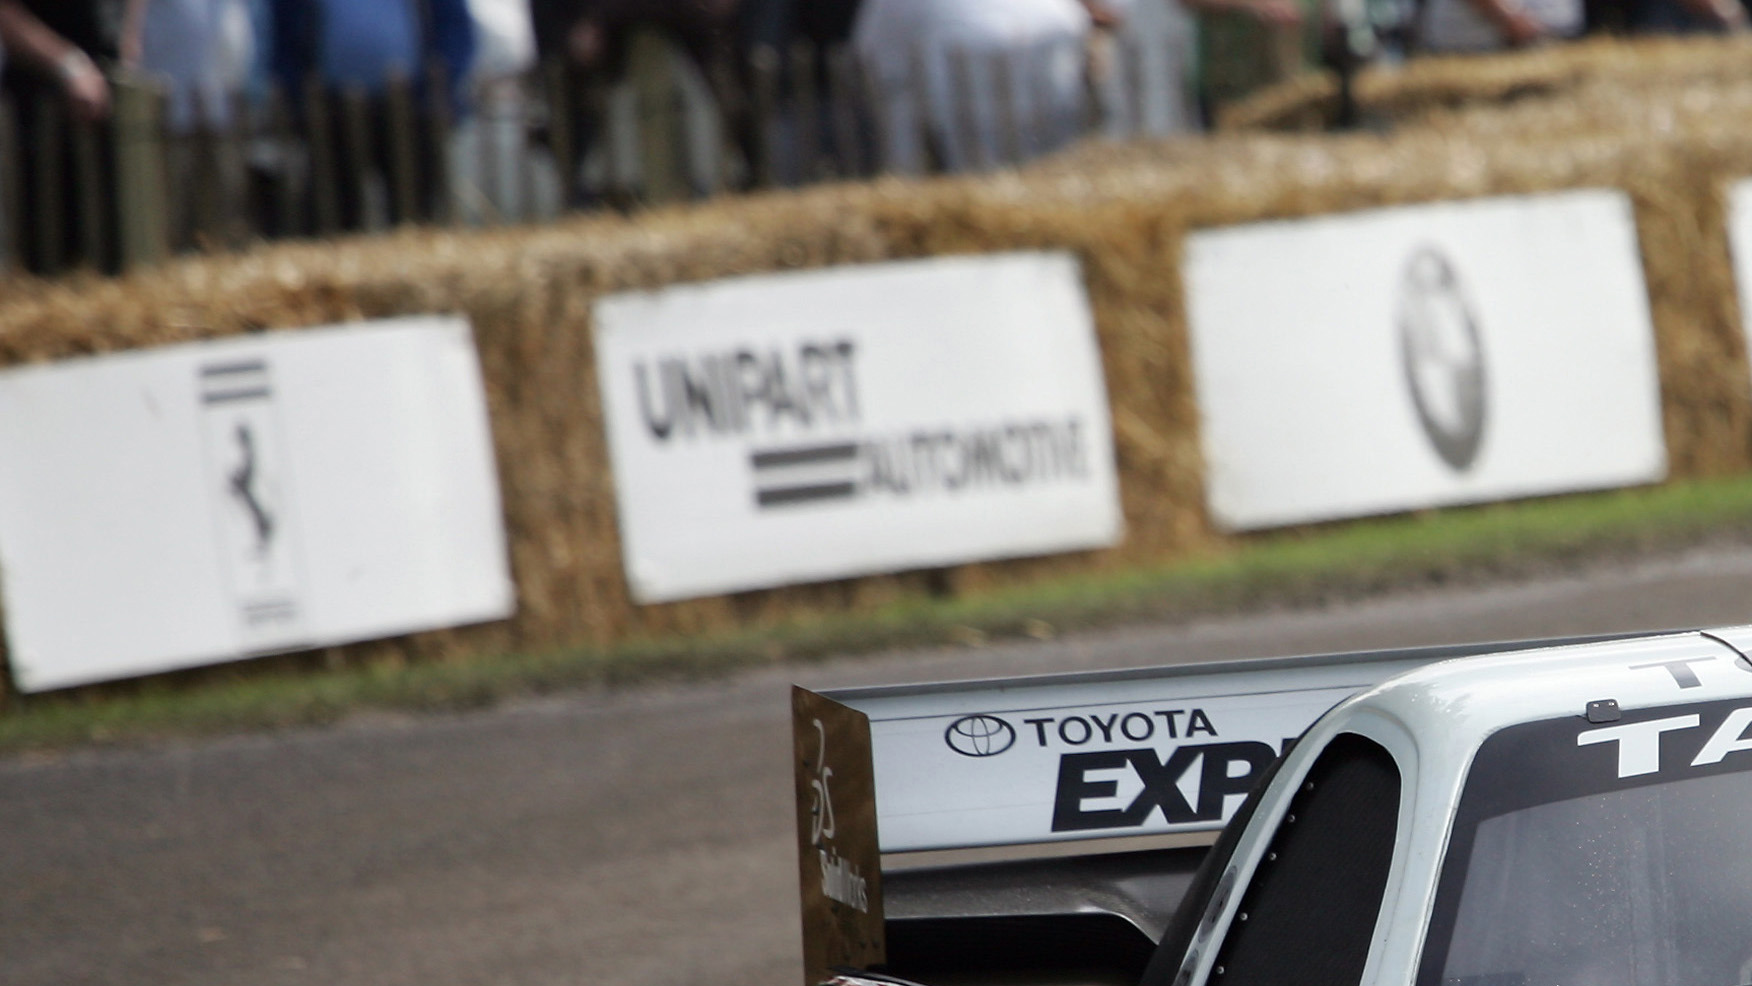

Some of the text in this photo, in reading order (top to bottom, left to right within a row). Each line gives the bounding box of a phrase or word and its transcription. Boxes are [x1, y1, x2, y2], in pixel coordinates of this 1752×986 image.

[632, 338, 861, 442] UNIPART
[858, 415, 1090, 497] AUTOMOTIVE
[1023, 708, 1218, 748] TOYOTA
[1050, 737, 1300, 834] EXP
